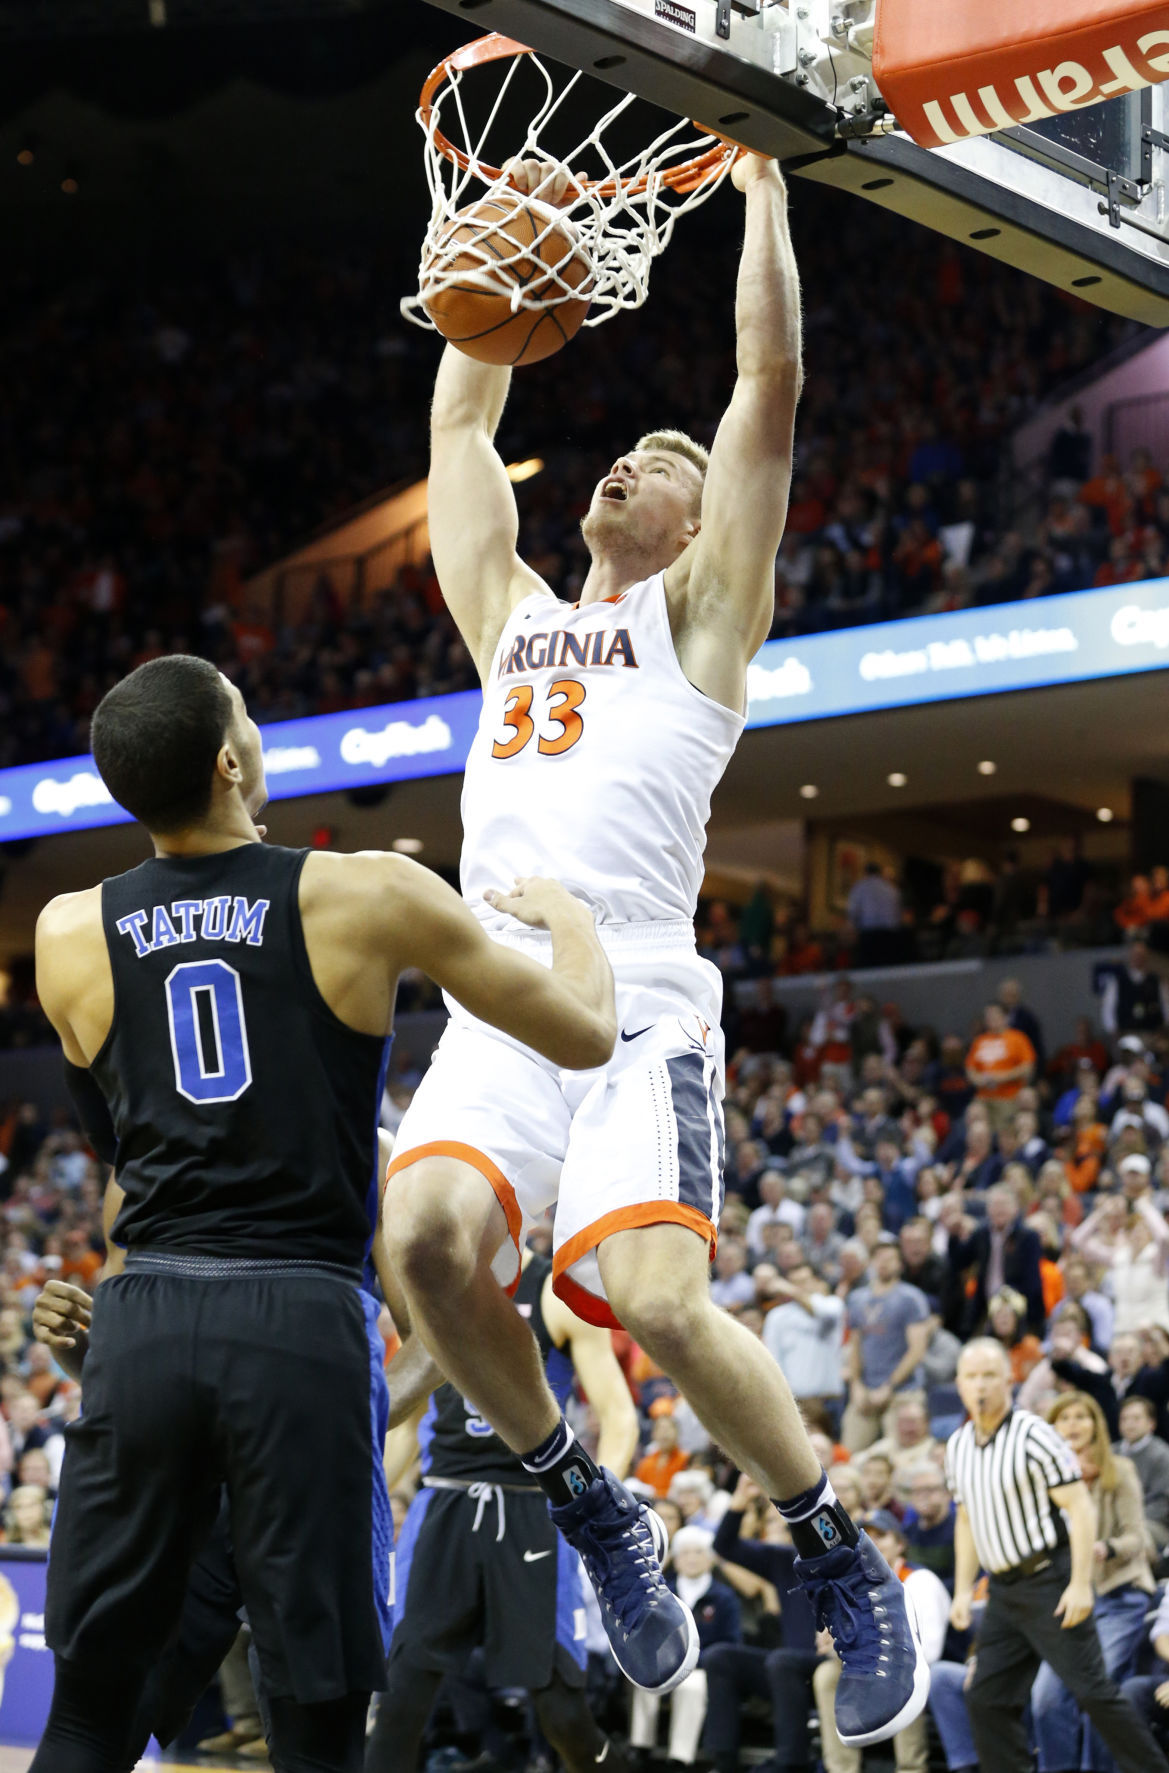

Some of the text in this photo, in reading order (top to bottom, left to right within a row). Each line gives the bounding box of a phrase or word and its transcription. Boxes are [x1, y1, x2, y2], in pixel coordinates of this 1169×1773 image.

[656, 0, 695, 26] SPALDING
[498, 628, 640, 680] RGINIA
[491, 679, 587, 760] 33
[116, 896, 270, 958] TATUM
[164, 958, 253, 1105] 0
